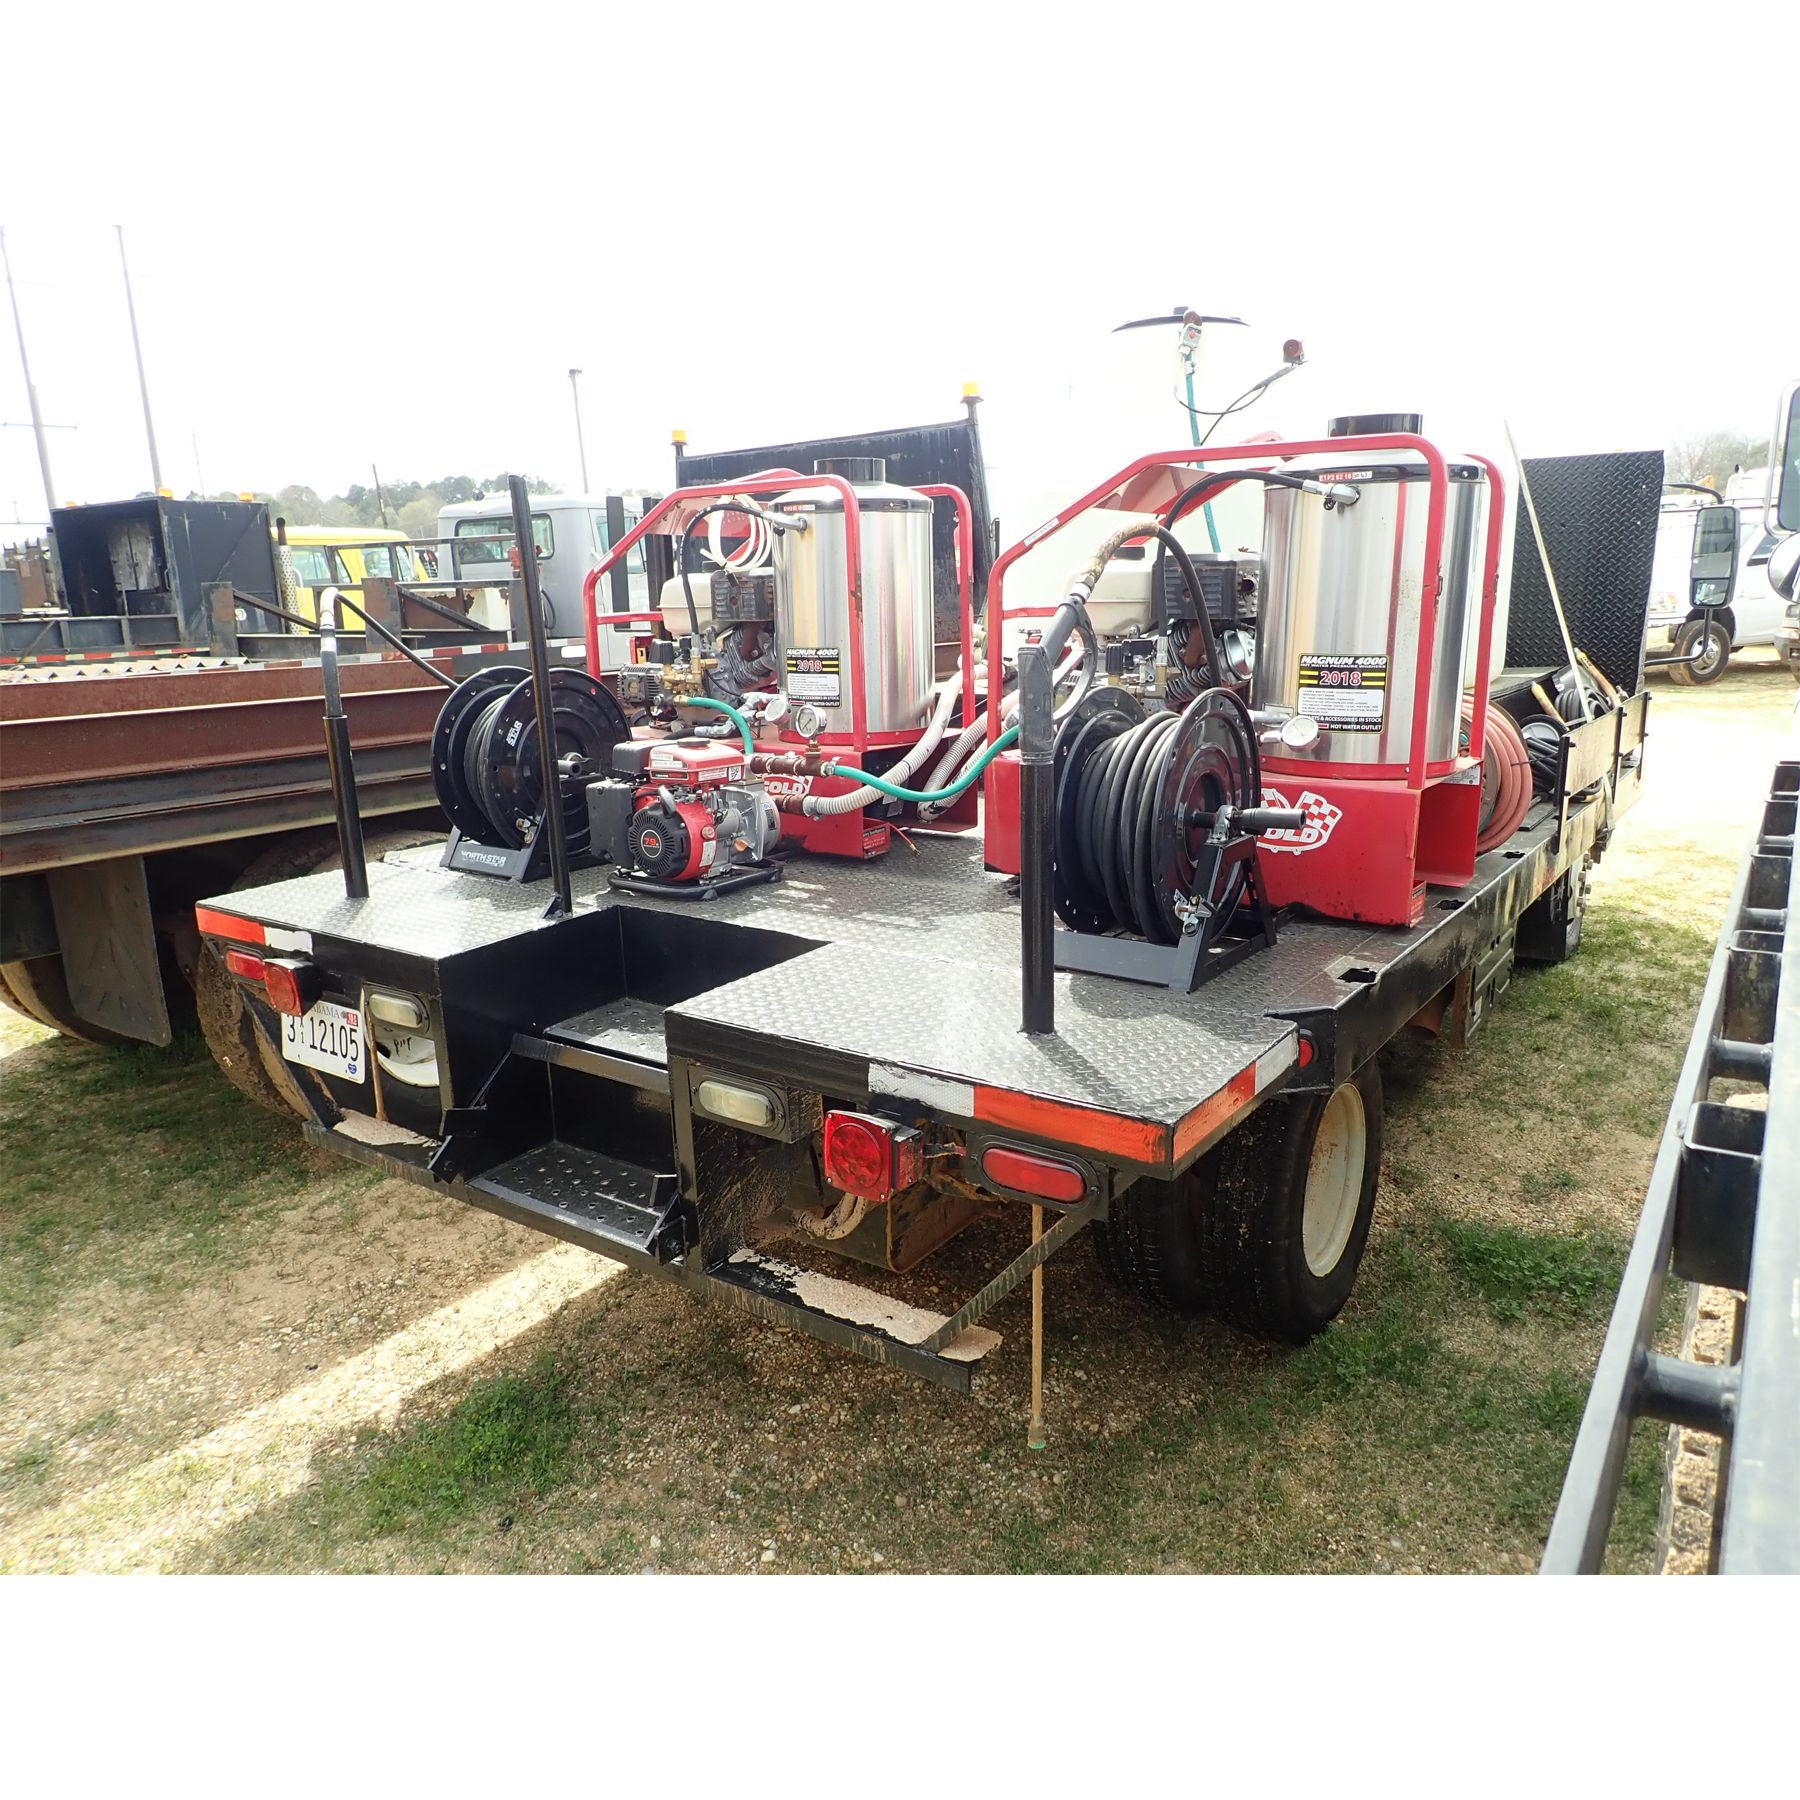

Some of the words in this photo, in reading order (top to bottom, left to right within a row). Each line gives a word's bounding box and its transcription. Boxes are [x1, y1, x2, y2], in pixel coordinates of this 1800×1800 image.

[786, 648, 816, 656] MAGNUM
[796, 659, 823, 672] 2018
[1300, 656, 1355, 665] MAGNUM
[1355, 656, 1387, 665] 4000
[1319, 670, 1362, 686] 2018
[309, 1016, 359, 1062] 12105
